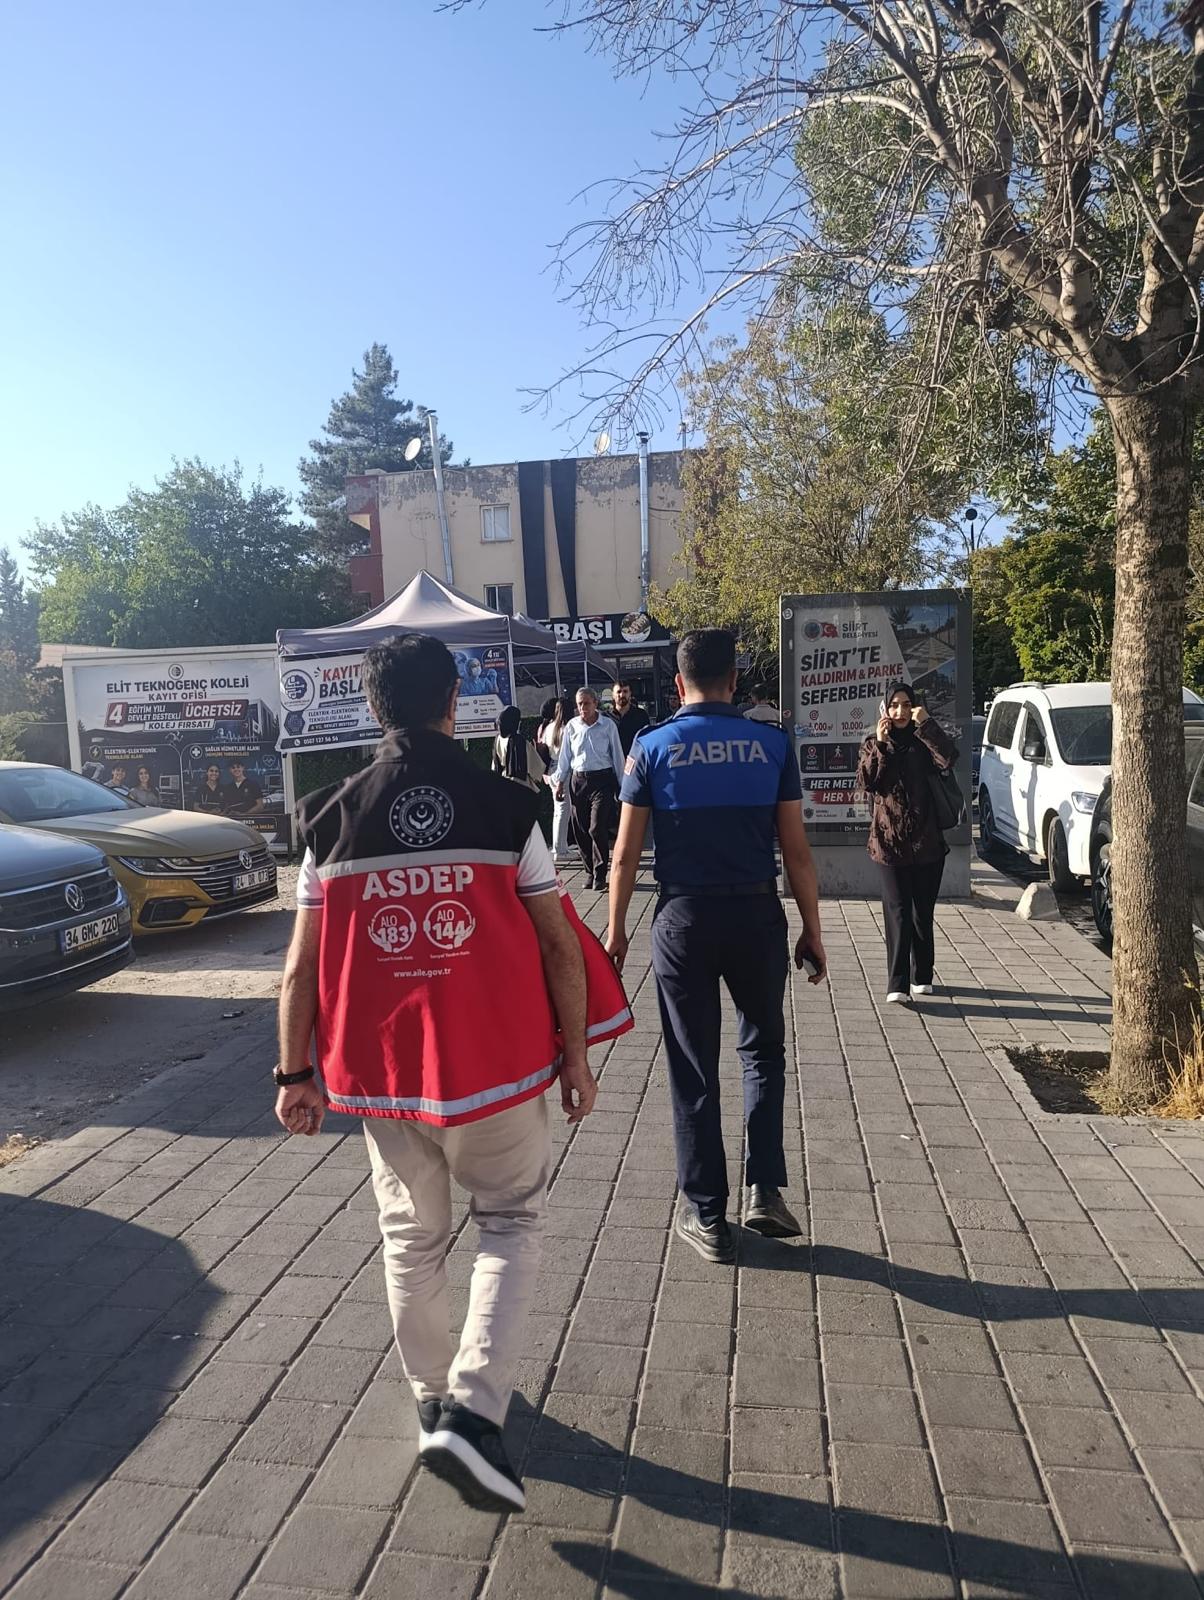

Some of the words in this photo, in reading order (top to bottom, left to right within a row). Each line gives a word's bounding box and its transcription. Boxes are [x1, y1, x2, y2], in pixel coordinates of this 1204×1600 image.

[546, 620, 612, 645] BAŞI
[800, 646, 881, 671] SİİRT'TE
[106, 680, 131, 693] ELİT
[134, 679, 207, 692] TEKNOGENÇ
[211, 675, 249, 689] KOLEJİ
[801, 669, 857, 688] KALDIRIM
[859, 670, 865, 679] &
[868, 663, 903, 679] PARKE
[148, 692, 178, 701] KAYIT
[181, 691, 207, 700] OFİSİ
[320, 678, 365, 698] BAŞLA
[800, 677, 904, 706] SEFERBERLİ
[109, 704, 123, 724] 4
[127, 714, 151, 722] DEVLET
[152, 712, 181, 721] DESTEKLİ
[128, 704, 152, 714] EĞİTİM
[153, 705, 166, 713] YILI
[185, 701, 242, 718] ÜCRETSİZ
[148, 721, 175, 730] KOLEJ
[178, 720, 211, 729] FIRSATI
[841, 721, 863, 730] 10.000
[667, 740, 768, 768] ZABITA
[810, 779, 831, 789] HER
[833, 779, 858, 789] METR
[822, 792, 844, 802] HER
[363, 865, 474, 901] ASDEP
[381, 915, 398, 928] ALO
[437, 909, 455, 922] ALO
[66, 928, 79, 947] 34
[81, 922, 99, 941] GMC
[101, 916, 118, 935] 220
[378, 925, 409, 944] 183
[432, 920, 465, 940] 144
[394, 968, 451, 978] www.aile.gov.tr
